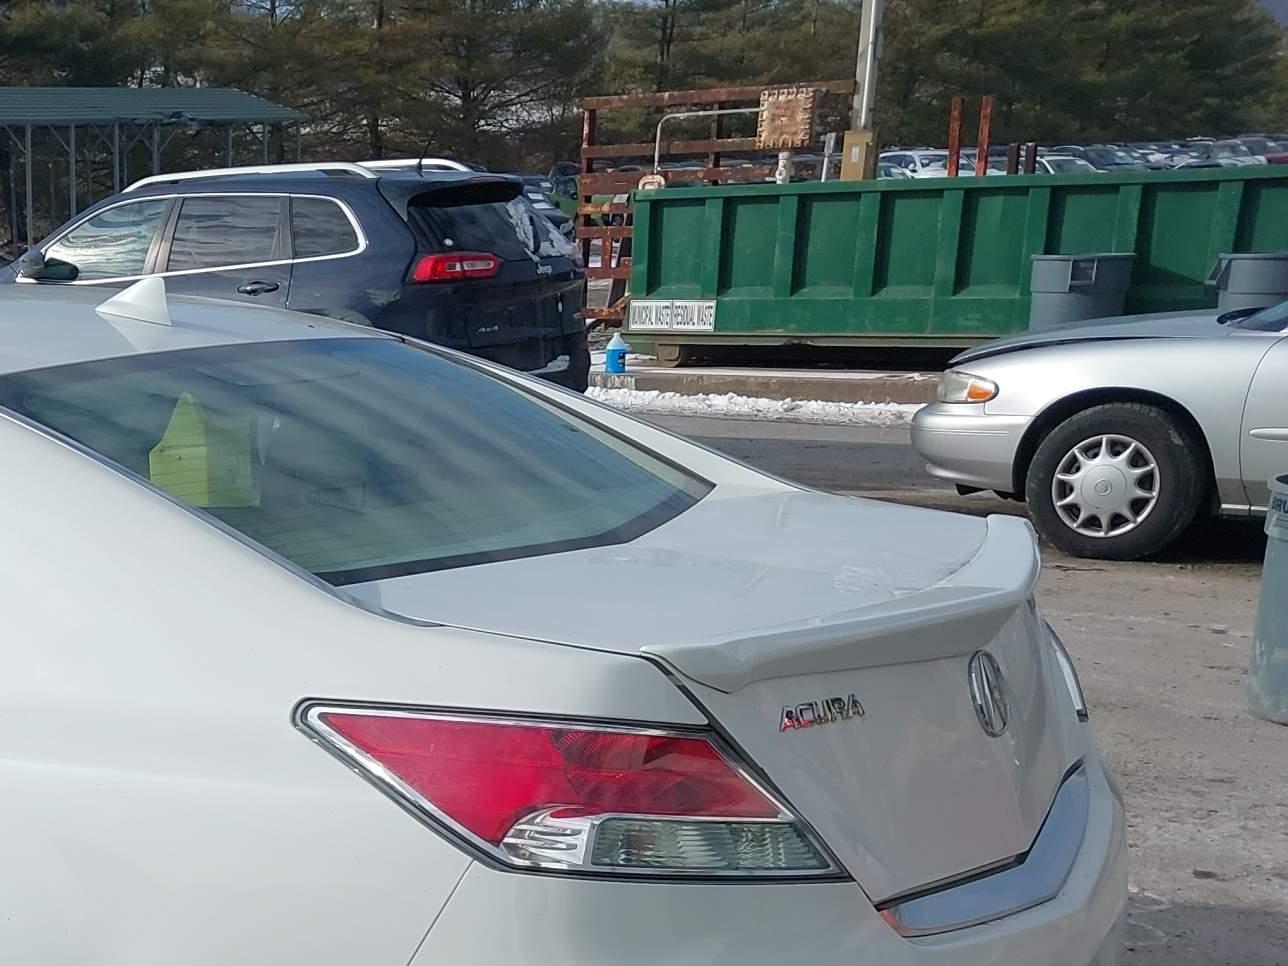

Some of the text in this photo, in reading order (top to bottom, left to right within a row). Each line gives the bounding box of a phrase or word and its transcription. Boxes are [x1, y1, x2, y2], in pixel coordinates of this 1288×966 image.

[655, 304, 671, 326] WASTE
[675, 304, 713, 327] RESIDUAL WASTE
[779, 693, 865, 732] ACURA
